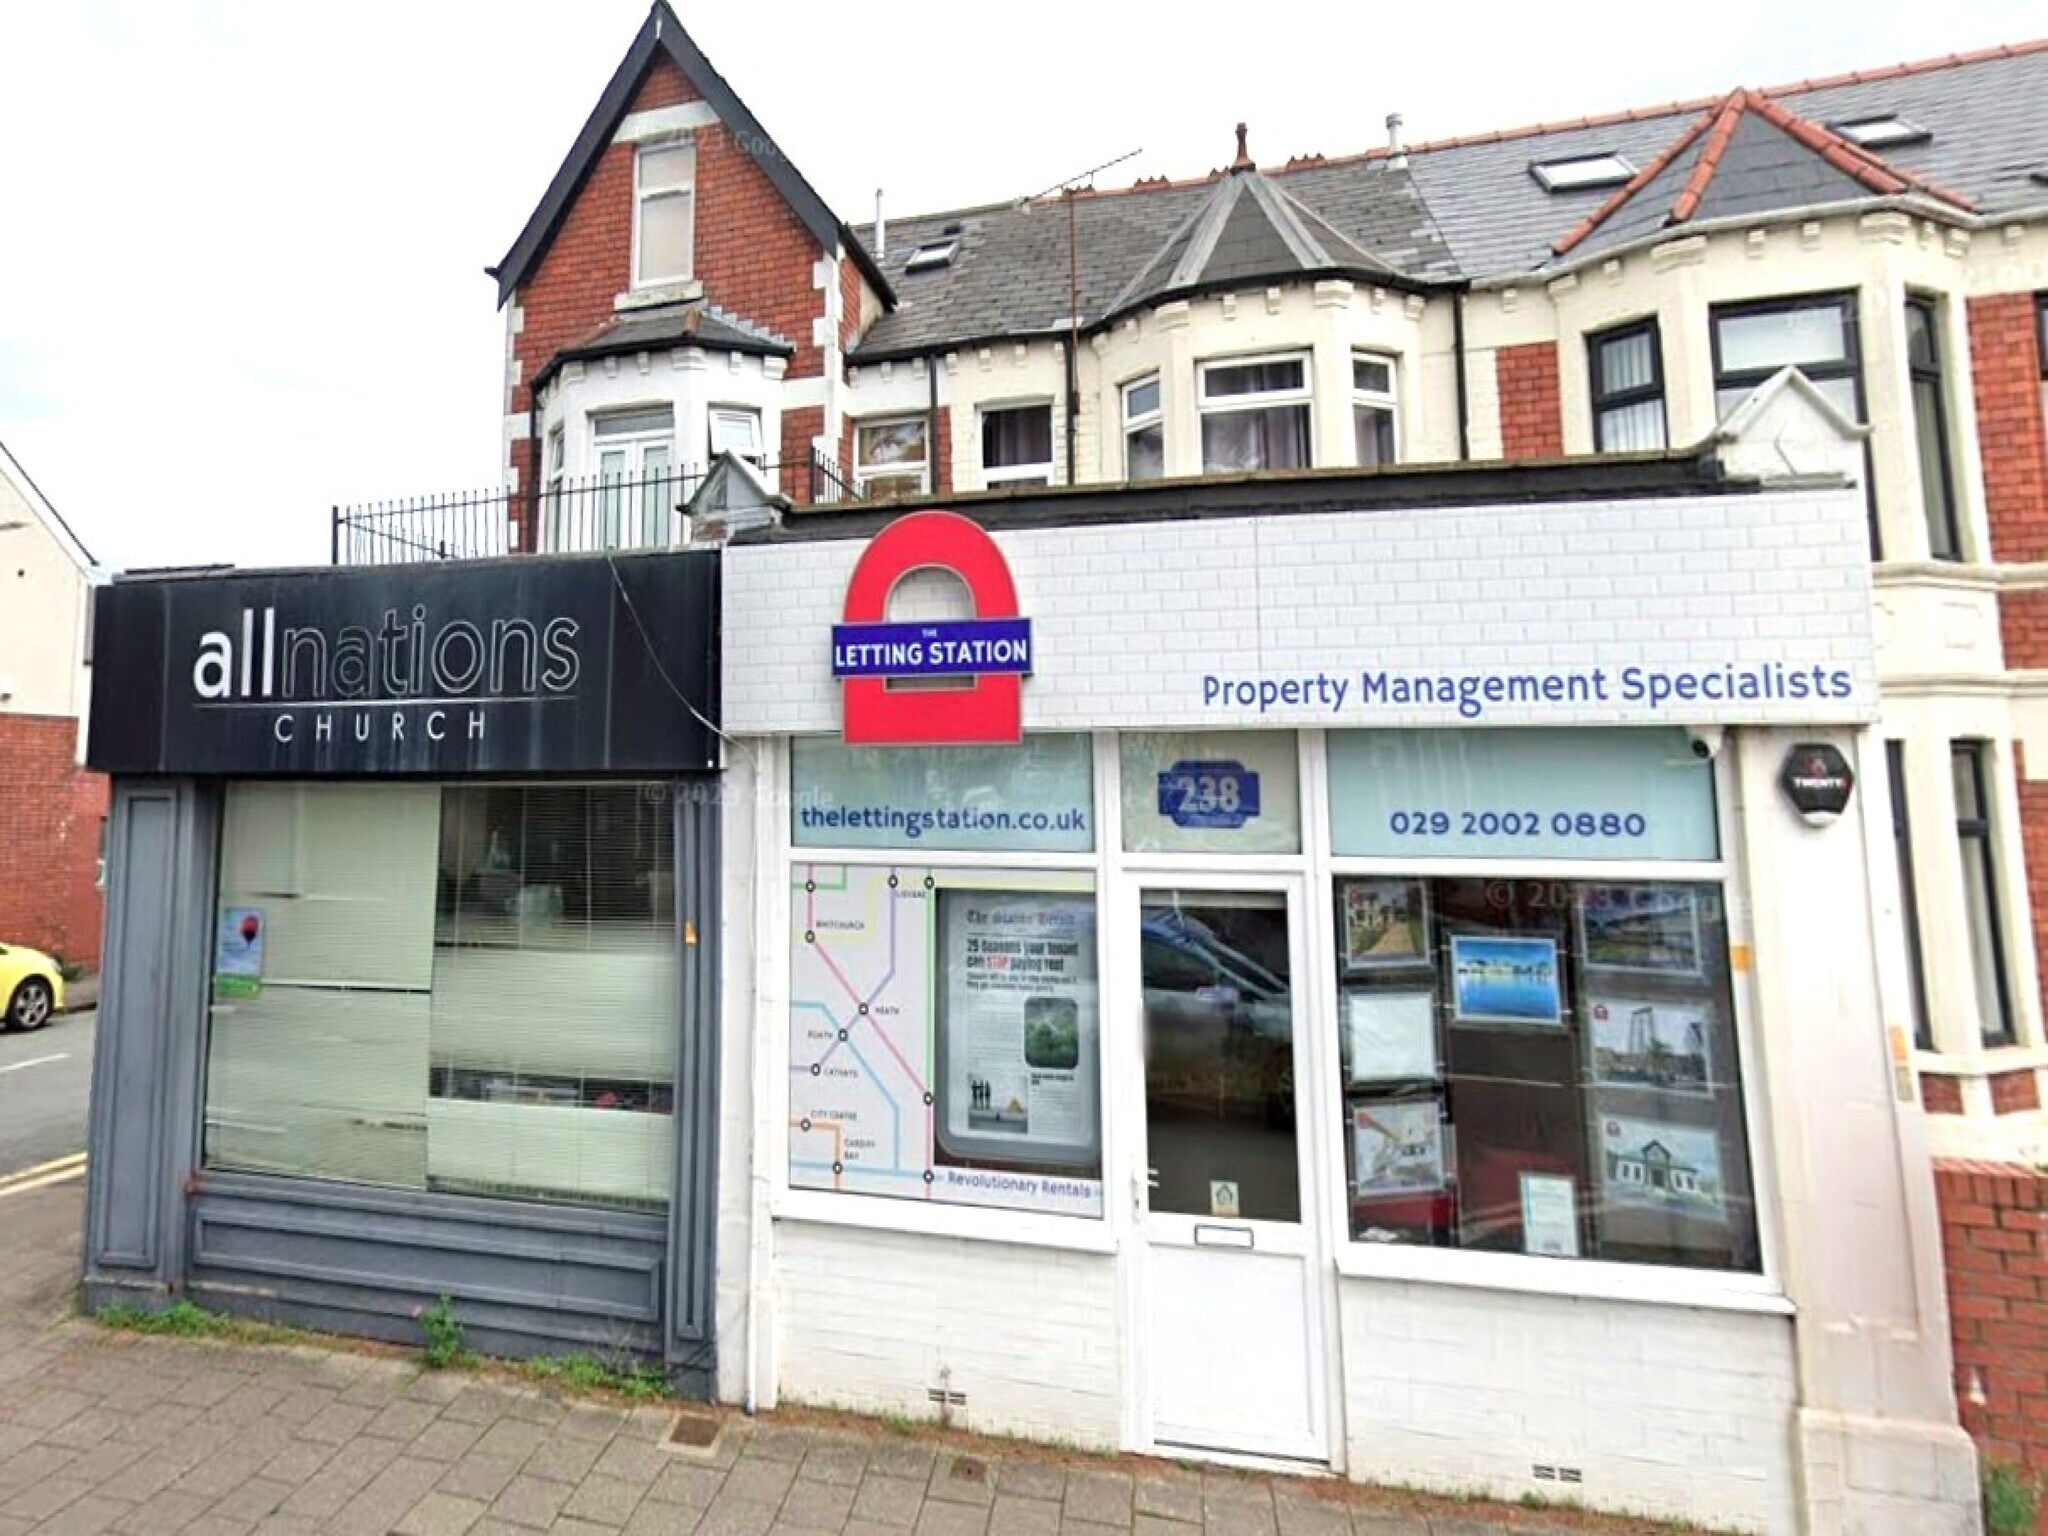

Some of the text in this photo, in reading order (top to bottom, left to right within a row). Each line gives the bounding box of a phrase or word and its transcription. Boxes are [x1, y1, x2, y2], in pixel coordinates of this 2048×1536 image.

[835, 640, 1027, 667] LETTING STATION
[1202, 662, 1852, 718] Property Management Specialists
[274, 711, 486, 743] CHURCH
[1177, 775, 1241, 813] 238
[800, 806, 1086, 838] thelettingstation.co.uk
[1390, 812, 1647, 836] 029 2002 0880
[949, 1172, 1091, 1198] Revolutionary Rentals
